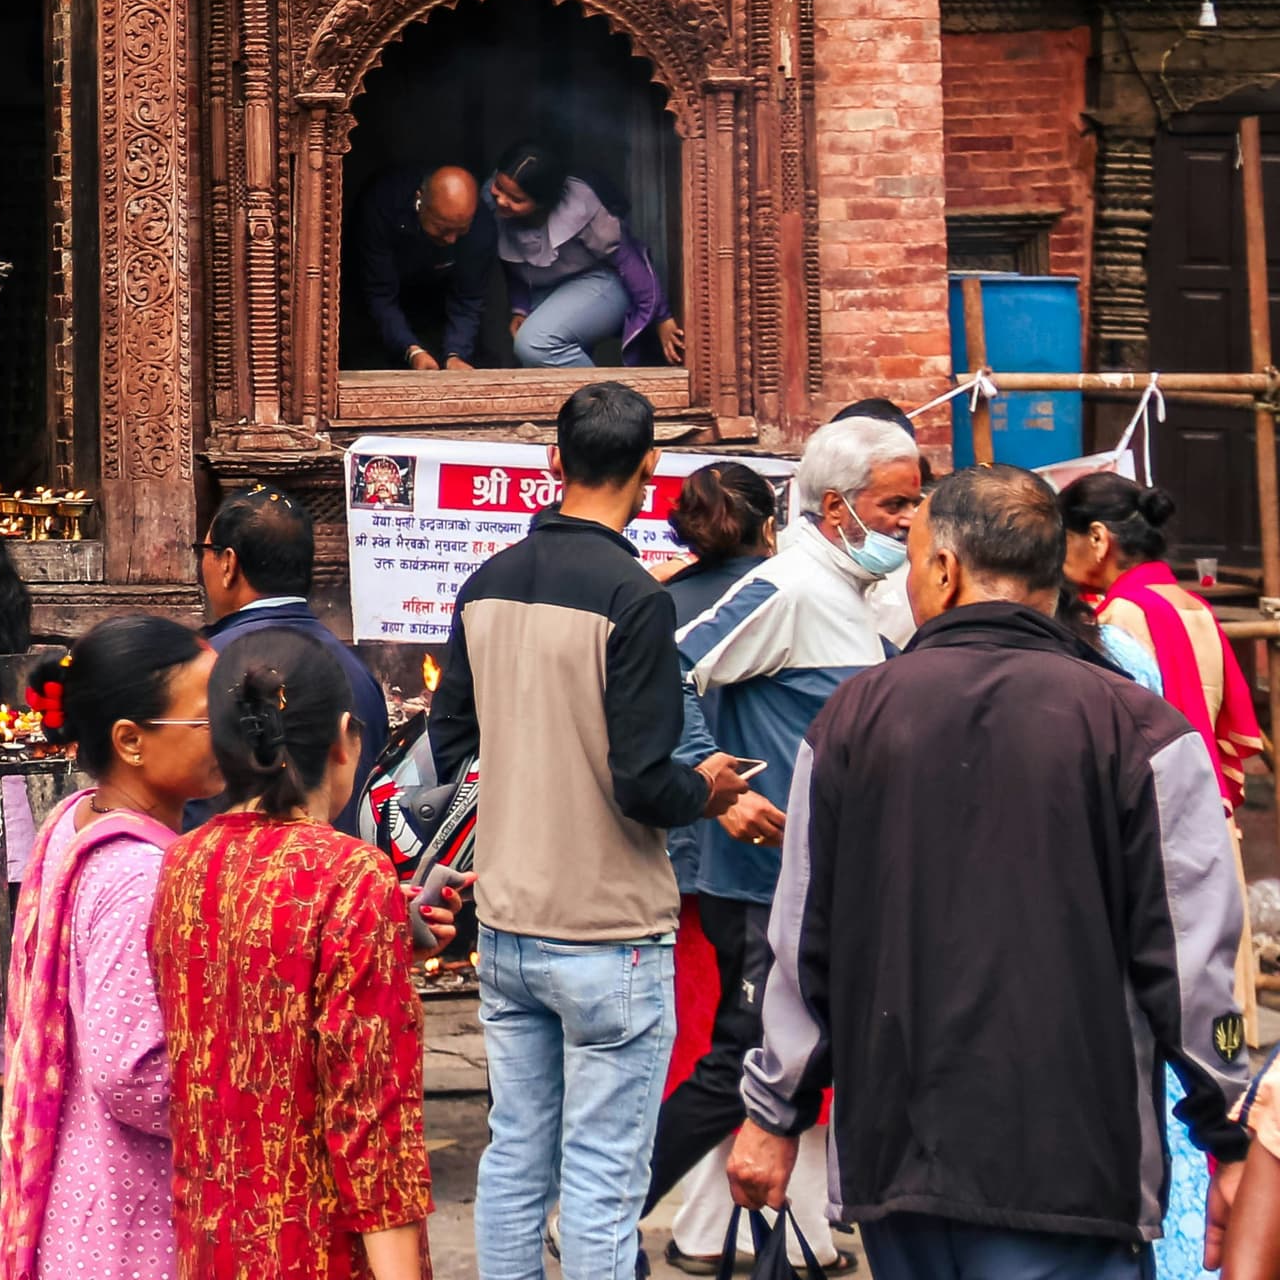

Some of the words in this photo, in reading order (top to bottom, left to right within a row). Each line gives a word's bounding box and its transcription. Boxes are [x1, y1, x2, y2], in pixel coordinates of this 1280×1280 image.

[472, 468, 511, 506] श्री
[355, 532, 368, 547] श्री
[374, 557, 395, 570] उक्त
[400, 556, 449, 573] कार्यक्रममा
[402, 597, 435, 616] महिला
